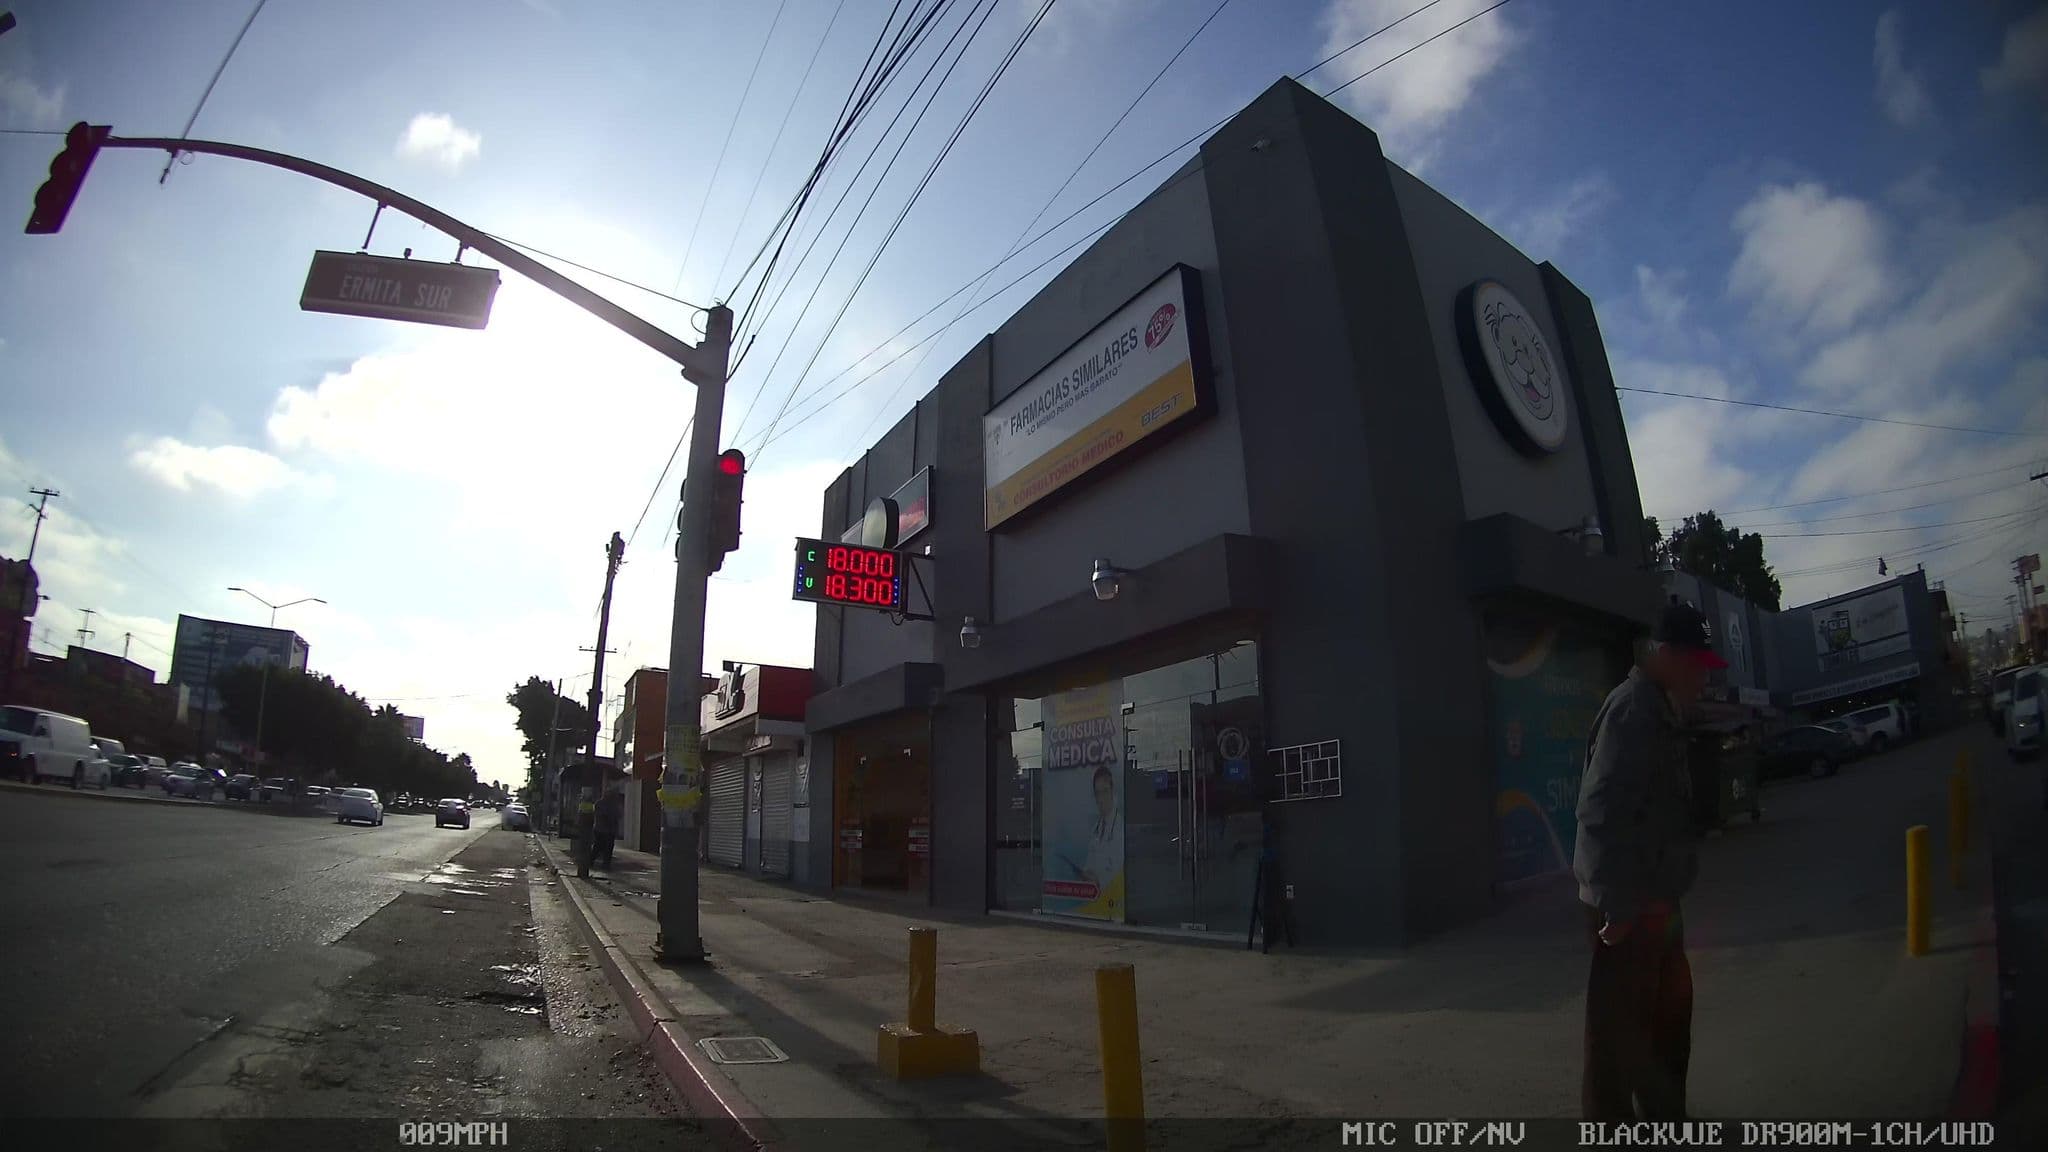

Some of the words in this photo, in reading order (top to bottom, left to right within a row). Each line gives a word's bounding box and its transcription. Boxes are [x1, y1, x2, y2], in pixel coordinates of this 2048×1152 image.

[339, 275, 400, 305] ERMITA
[415, 282, 453, 309] SUR
[1009, 376, 1070, 437] FARMACIAS
[1072, 327, 1138, 390] SIMILARES
[1056, 396, 1074, 415] PERO
[1141, 391, 1183, 427] BEST
[1013, 457, 1079, 505] CONSULTORIO
[808, 551, 816, 562] C
[827, 546, 895, 578] 18.000
[825, 573, 893, 606] 18.300
[1049, 717, 1114, 743] CONSULTA
